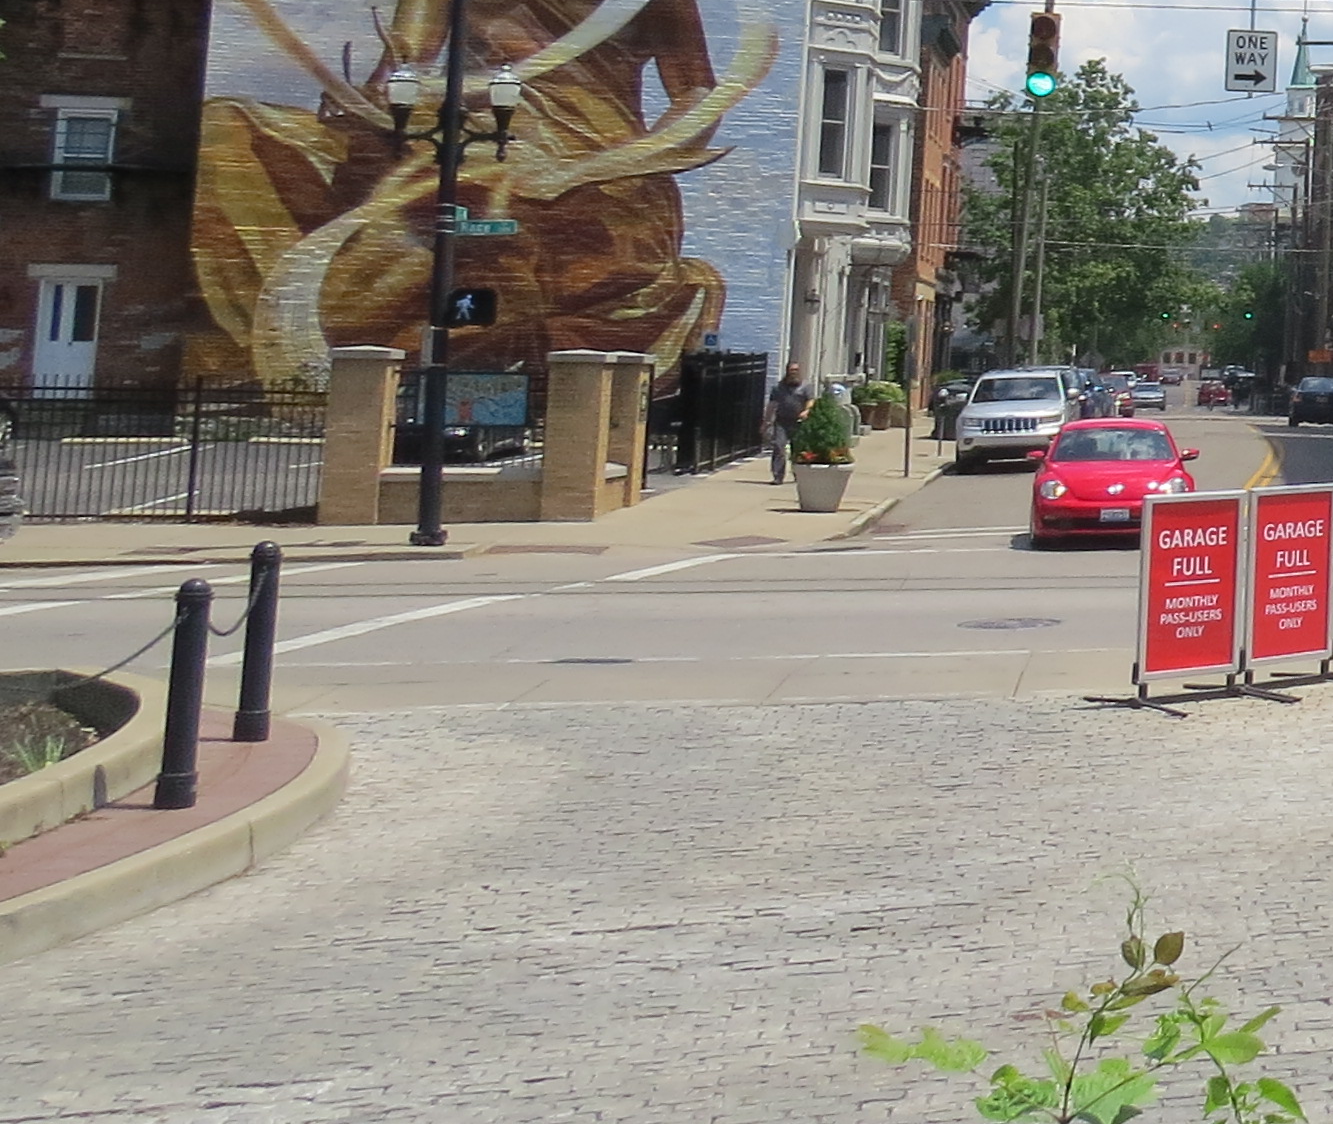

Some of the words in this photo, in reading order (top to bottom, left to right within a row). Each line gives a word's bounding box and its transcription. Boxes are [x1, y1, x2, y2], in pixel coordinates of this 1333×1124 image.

[1236, 35, 1268, 49] ONE
[1234, 52, 1269, 66] WAY
[1158, 526, 1228, 549] GARAGE
[1263, 519, 1324, 541] GARAGE
[1172, 556, 1213, 576] FULL
[1276, 549, 1311, 568] FULL
[1269, 584, 1315, 599] MONTHLY
[1165, 594, 1219, 609] MONTHLY
[1264, 599, 1317, 615] PASS-USERS
[1159, 608, 1223, 625] PASS-USERS
[1278, 616, 1303, 630] ONLY
[1175, 625, 1205, 638] ONLY
